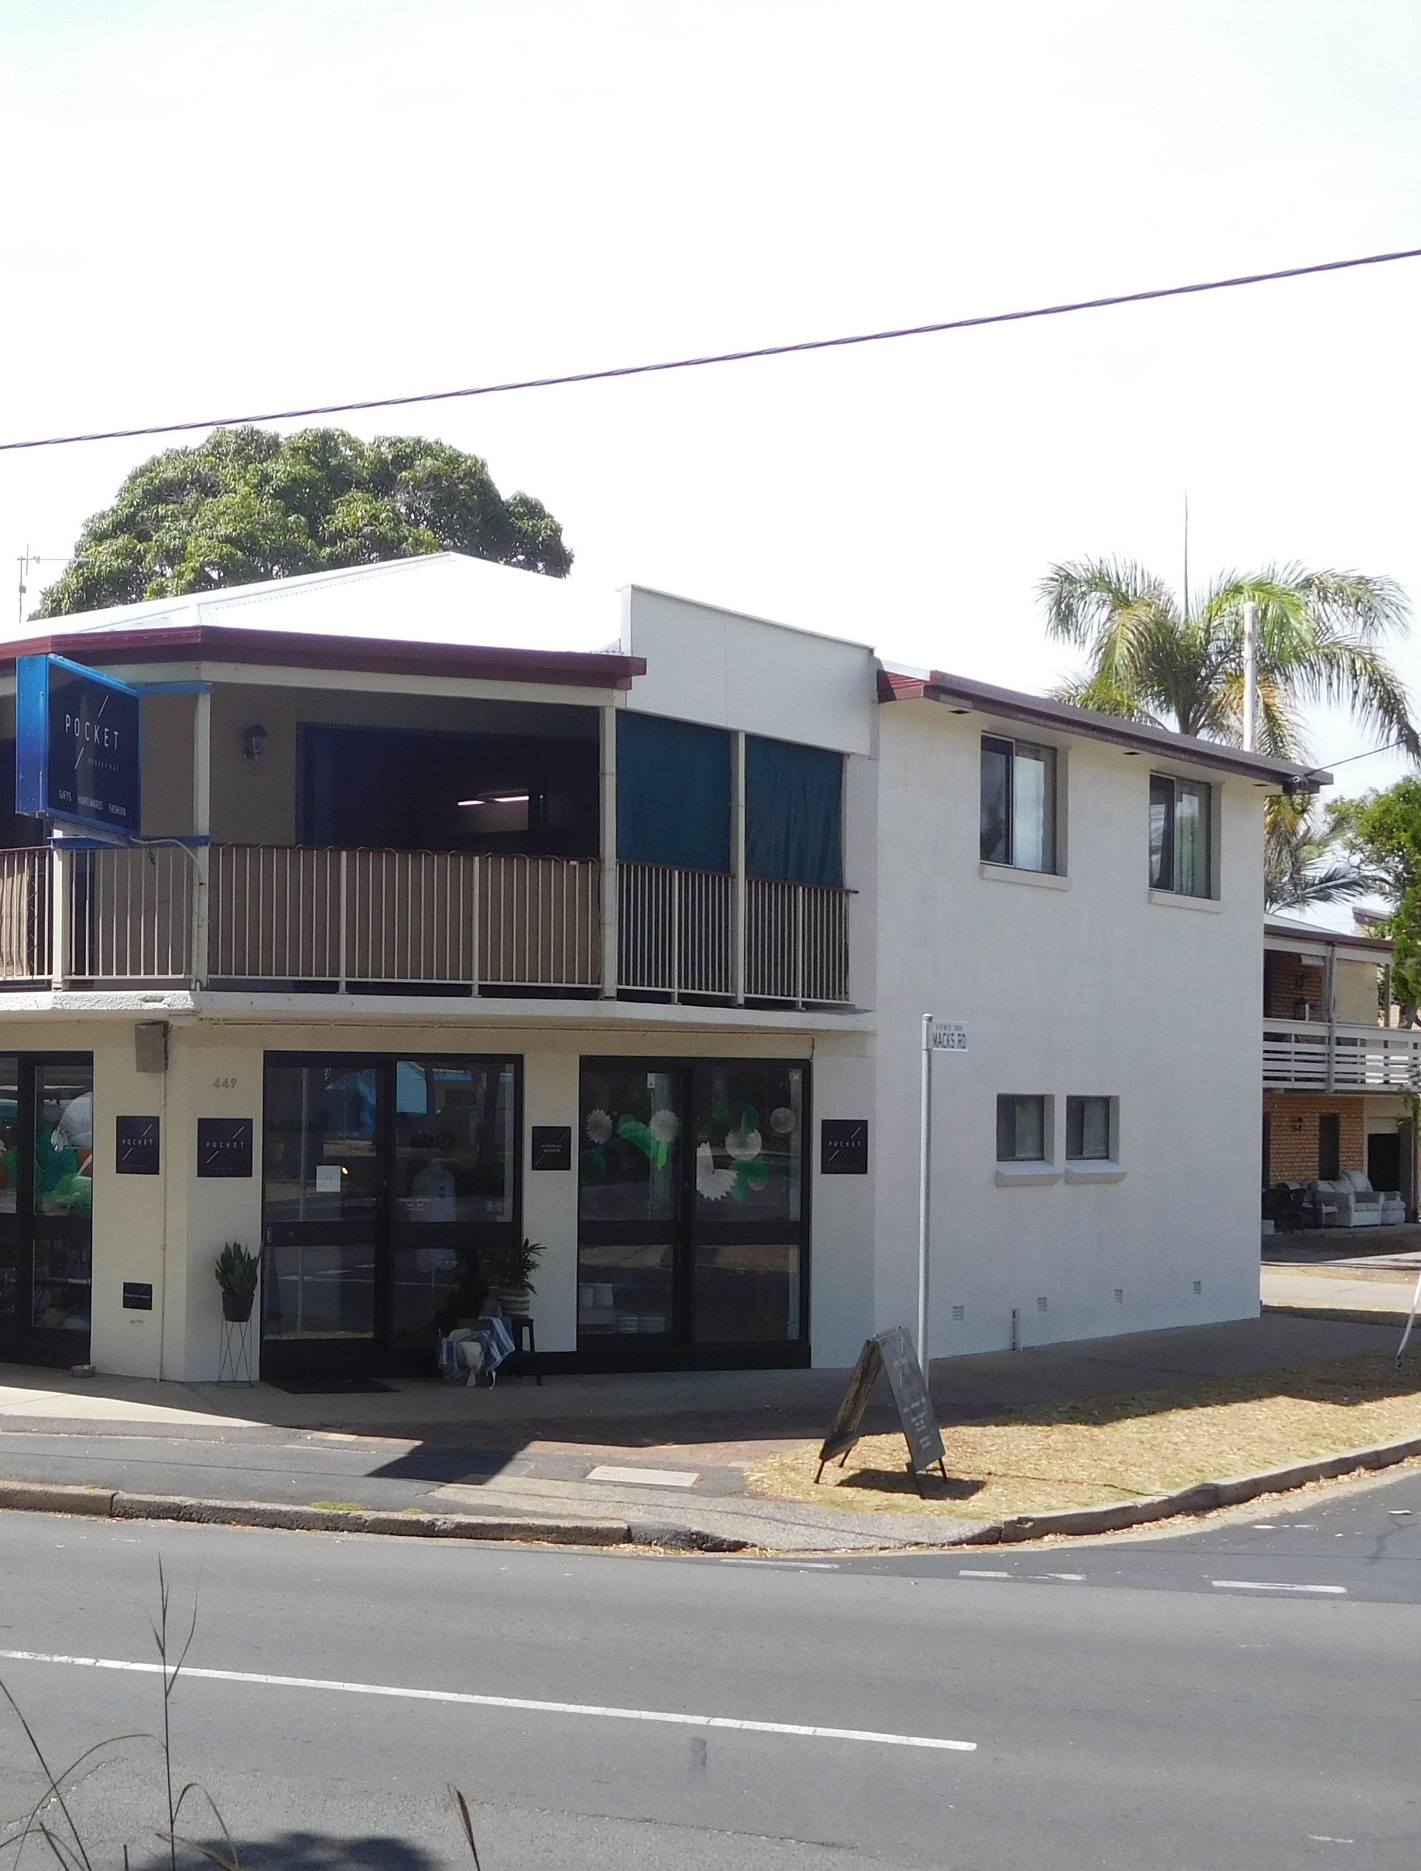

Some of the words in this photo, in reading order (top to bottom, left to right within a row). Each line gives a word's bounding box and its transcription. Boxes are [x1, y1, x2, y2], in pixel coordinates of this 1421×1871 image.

[65, 714, 119, 750] POCKET
[58, 789, 72, 802] GIFTS
[932, 1032, 955, 1049] MACKS
[957, 1033, 967, 1049] RD
[213, 1077, 237, 1089] 449
[122, 1138, 153, 1146] POCKET
[206, 1141, 245, 1149] POCKET
[828, 1140, 861, 1148] POCKET
